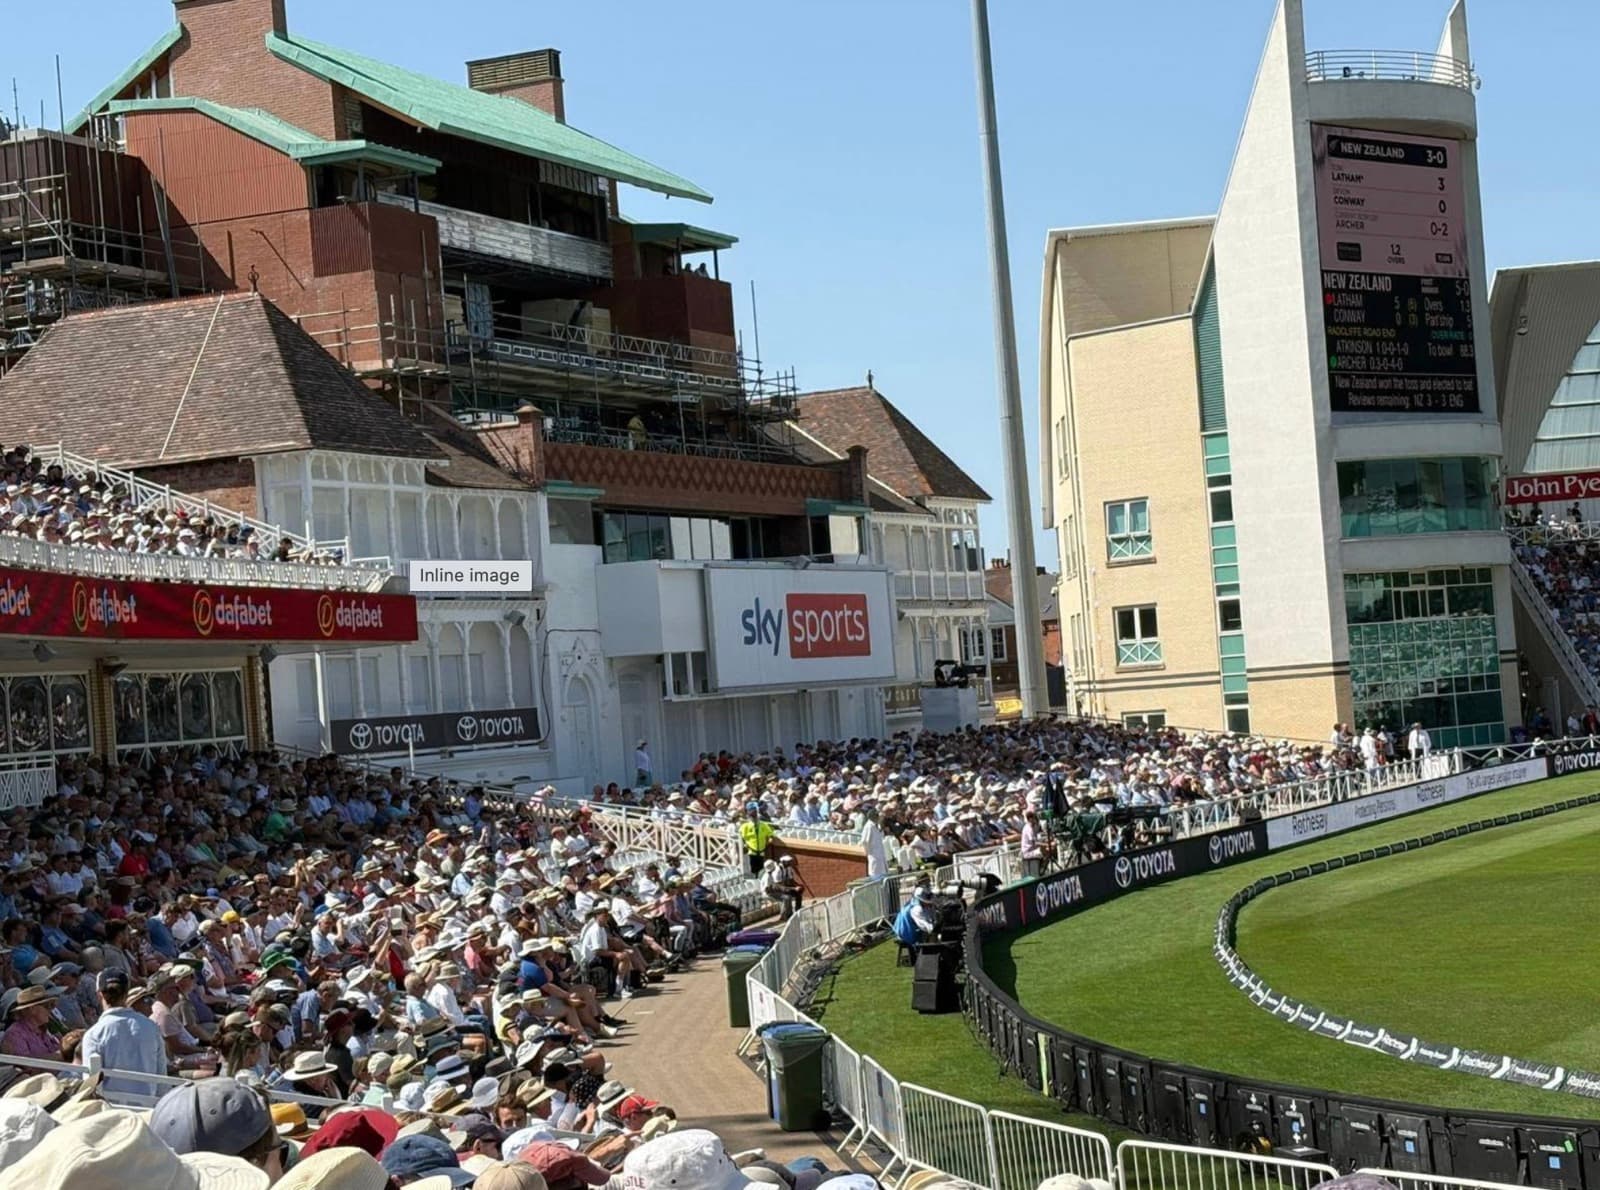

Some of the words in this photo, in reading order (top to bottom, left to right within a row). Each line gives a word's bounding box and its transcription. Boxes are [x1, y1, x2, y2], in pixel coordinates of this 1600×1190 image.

[1340, 142, 1362, 154] NEW
[1363, 144, 1405, 158] ZEALAND
[1426, 150, 1444, 164] 3-0
[1438, 178, 1446, 190] 3
[1334, 196, 1366, 206] CONWAY
[1438, 200, 1446, 213] 0
[1336, 220, 1365, 230] ARCHER
[1430, 222, 1448, 236] 0-2
[1324, 273, 1346, 288] NEW
[1348, 274, 1392, 291] ZEALAND
[1456, 280, 1470, 296] 5-0
[1332, 294, 1362, 307] LATHAM
[1394, 296, 1400, 310] 5
[1424, 298, 1444, 311] Overs
[1334, 309, 1366, 322] CONWAY
[1336, 340, 1372, 354] ATKINSON
[1338, 356, 1366, 369] ARCHER
[1508, 478, 1560, 498] John
[1563, 476, 1600, 498] Pye
[89, 586, 138, 628] dafabet
[214, 594, 272, 631] dafabet
[336, 600, 384, 632] dafabet
[742, 597, 783, 656] sky
[792, 604, 865, 652] sports
[374, 723, 424, 745] TOYOTA
[480, 716, 525, 737] TOYOTA
[1416, 784, 1446, 802] Rothesay
[1292, 812, 1328, 836] Rothesay
[1222, 830, 1256, 858] TOYOTA
[1132, 849, 1176, 880] TOYOTA
[1048, 875, 1084, 908] TOYOTA
